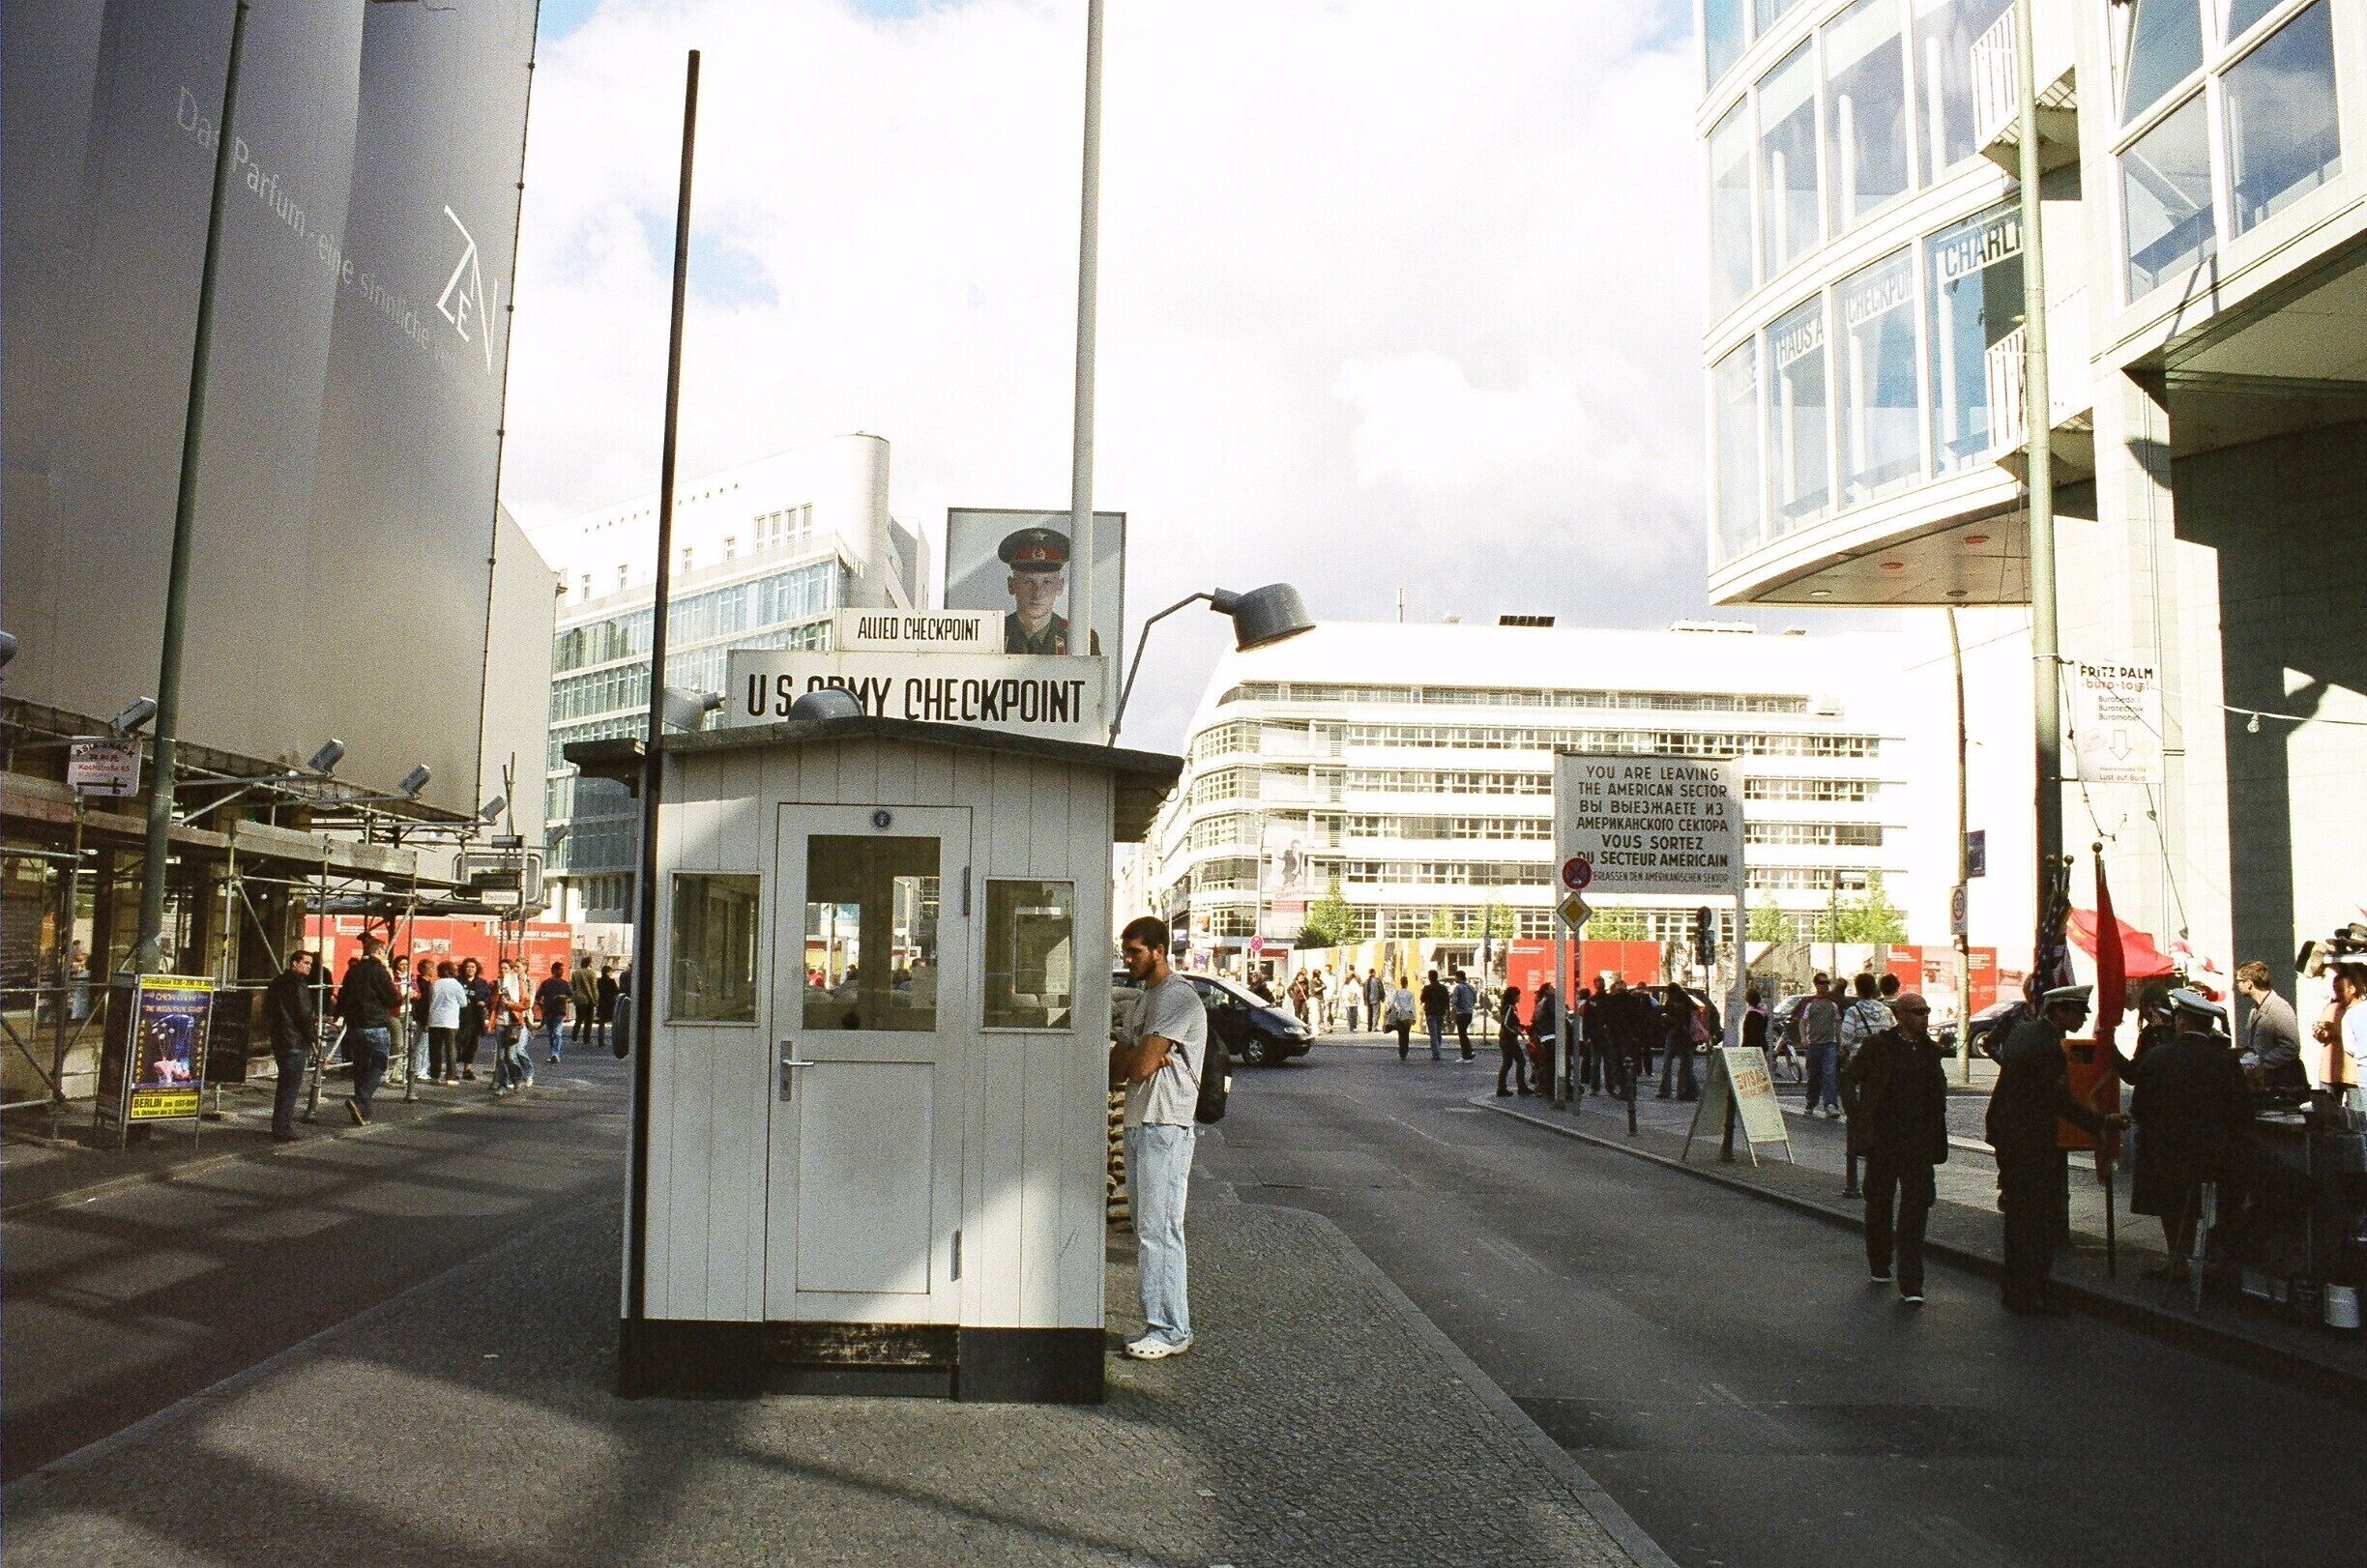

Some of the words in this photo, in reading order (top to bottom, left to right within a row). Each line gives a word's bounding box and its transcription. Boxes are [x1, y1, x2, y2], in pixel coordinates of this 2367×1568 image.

[233, 136, 306, 237] Parfum
[1944, 221, 2023, 277] CHARLI
[858, 617, 899, 640] ALLIED
[903, 617, 981, 641] CHECKPOINT
[904, 678, 1086, 723] CHECKPOINT
[1586, 766, 1615, 779] YOU
[1624, 767, 1651, 779] ARE
[1660, 768, 1719, 781] LEAVING
[1578, 782, 1600, 795] THE
[1608, 783, 1673, 797] AMERICAN
[1680, 784, 1727, 798] SECTOR
[1579, 800, 1602, 813] ВЫ
[1610, 800, 1696, 815] ВЫЕЗЖАЕТЕ
[1705, 802, 1724, 816] ИЗ
[1576, 817, 1674, 831] АМЕРИКАНСКОГО
[1679, 819, 1728, 832] СЕКТОРА
[1601, 834, 1642, 849] VOUS
[1650, 835, 1703, 851] SORTEZ
[1600, 852, 1656, 866] SECTEUR
[1593, 871, 1628, 881] ERLASSEN
[133, 1097, 162, 1109] BERLIN
